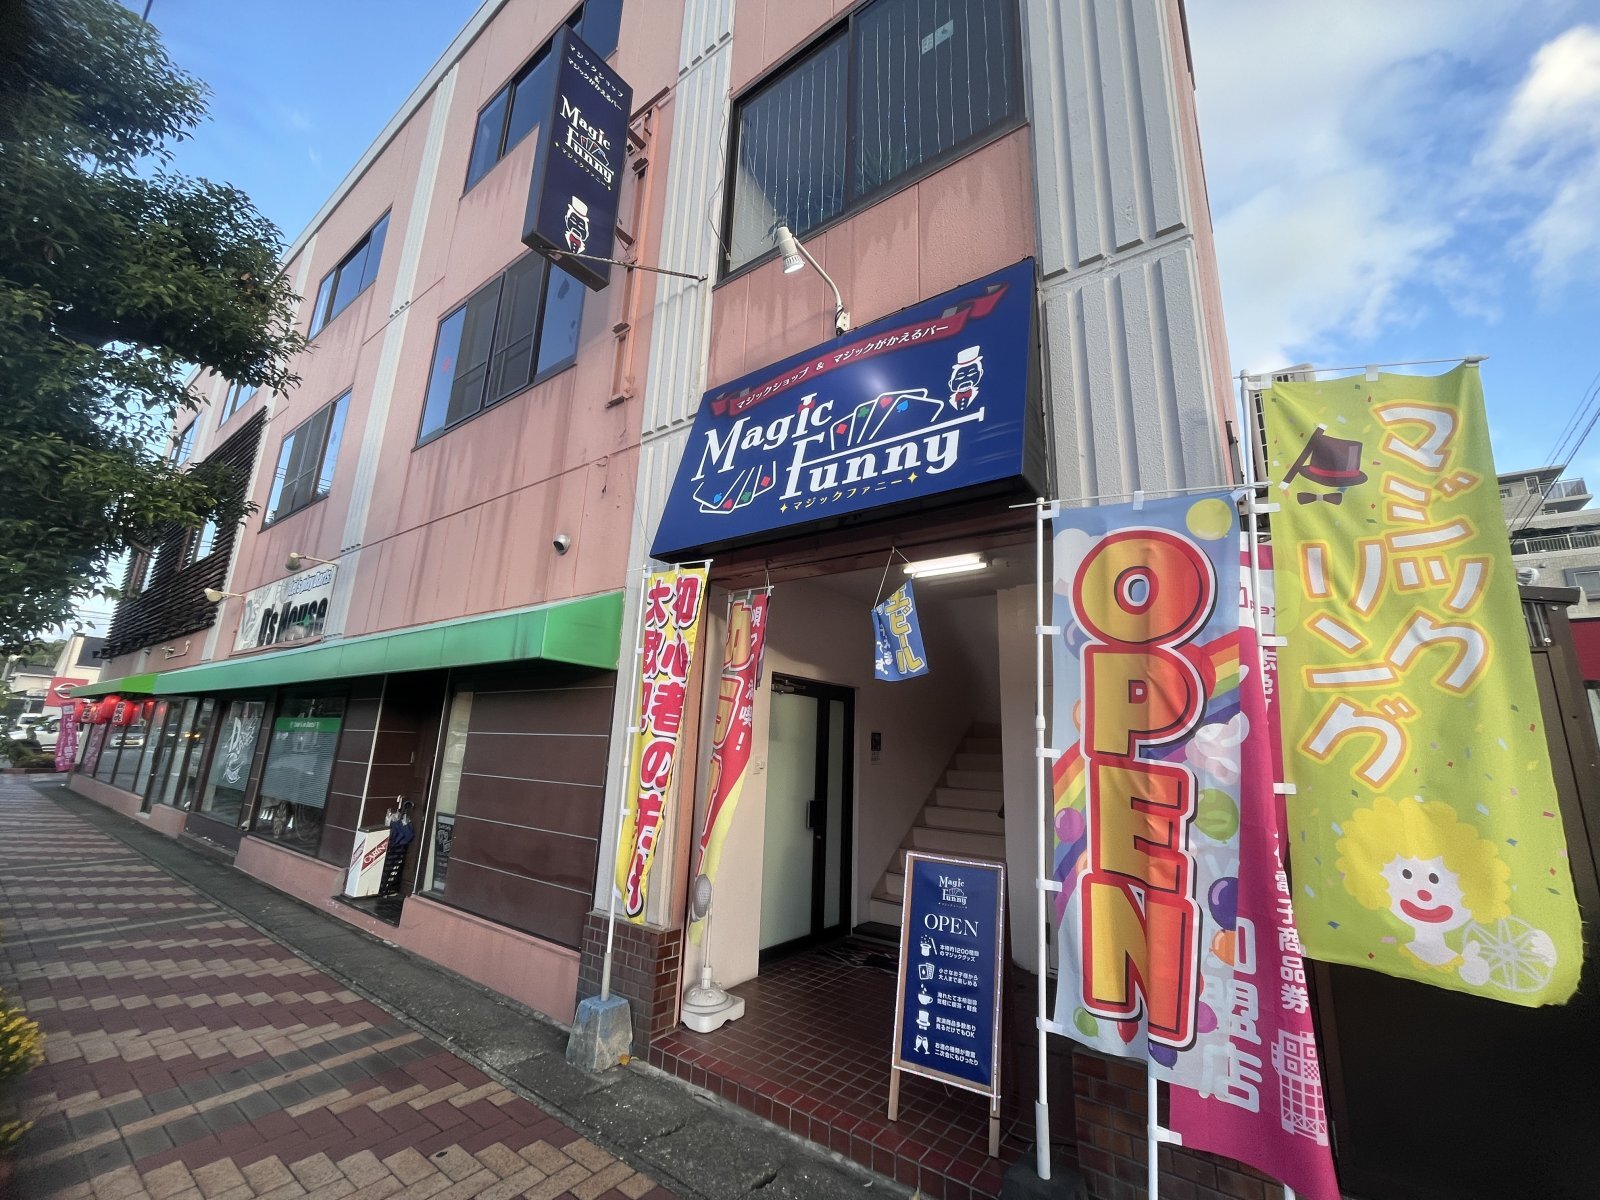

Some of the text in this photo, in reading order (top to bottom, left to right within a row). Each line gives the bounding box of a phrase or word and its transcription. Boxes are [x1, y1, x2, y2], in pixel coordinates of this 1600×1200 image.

[560, 94, 611, 151] Magic
[564, 125, 615, 184] Funny
[736, 324, 949, 409] マジックショップ & マジックがかえるバー
[691, 393, 835, 482] Magic
[779, 408, 985, 502] Funny
[793, 480, 903, 510] マジックファニー
[1373, 401, 1491, 697] マジック
[1068, 526, 1217, 1051] OPEN
[939, 875, 965, 889] Magic
[942, 888, 968, 906] Funny
[924, 913, 979, 937] OPEN
